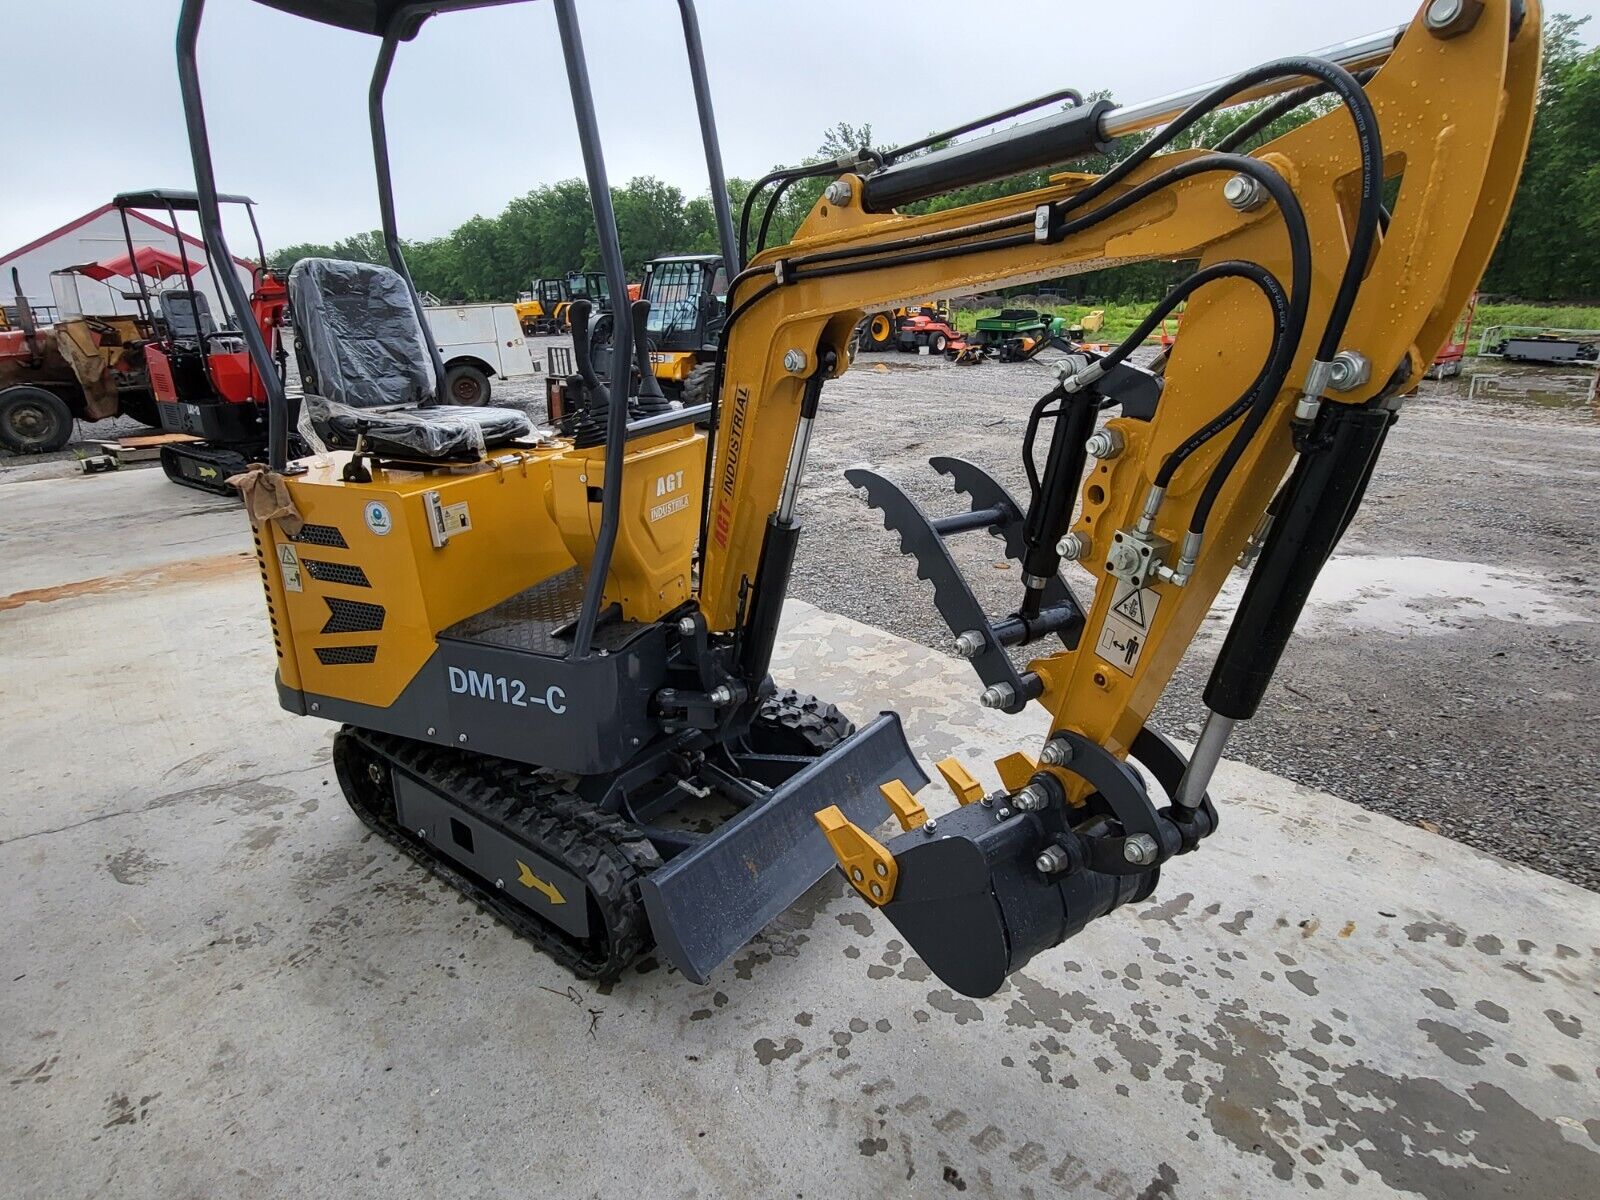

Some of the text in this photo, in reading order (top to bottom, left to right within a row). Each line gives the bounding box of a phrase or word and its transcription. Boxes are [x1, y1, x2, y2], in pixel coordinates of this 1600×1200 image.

[656, 470, 684, 497] AGT
[713, 387, 748, 551] AGT INDUSTRIAL
[448, 666, 567, 714] DM12-C
